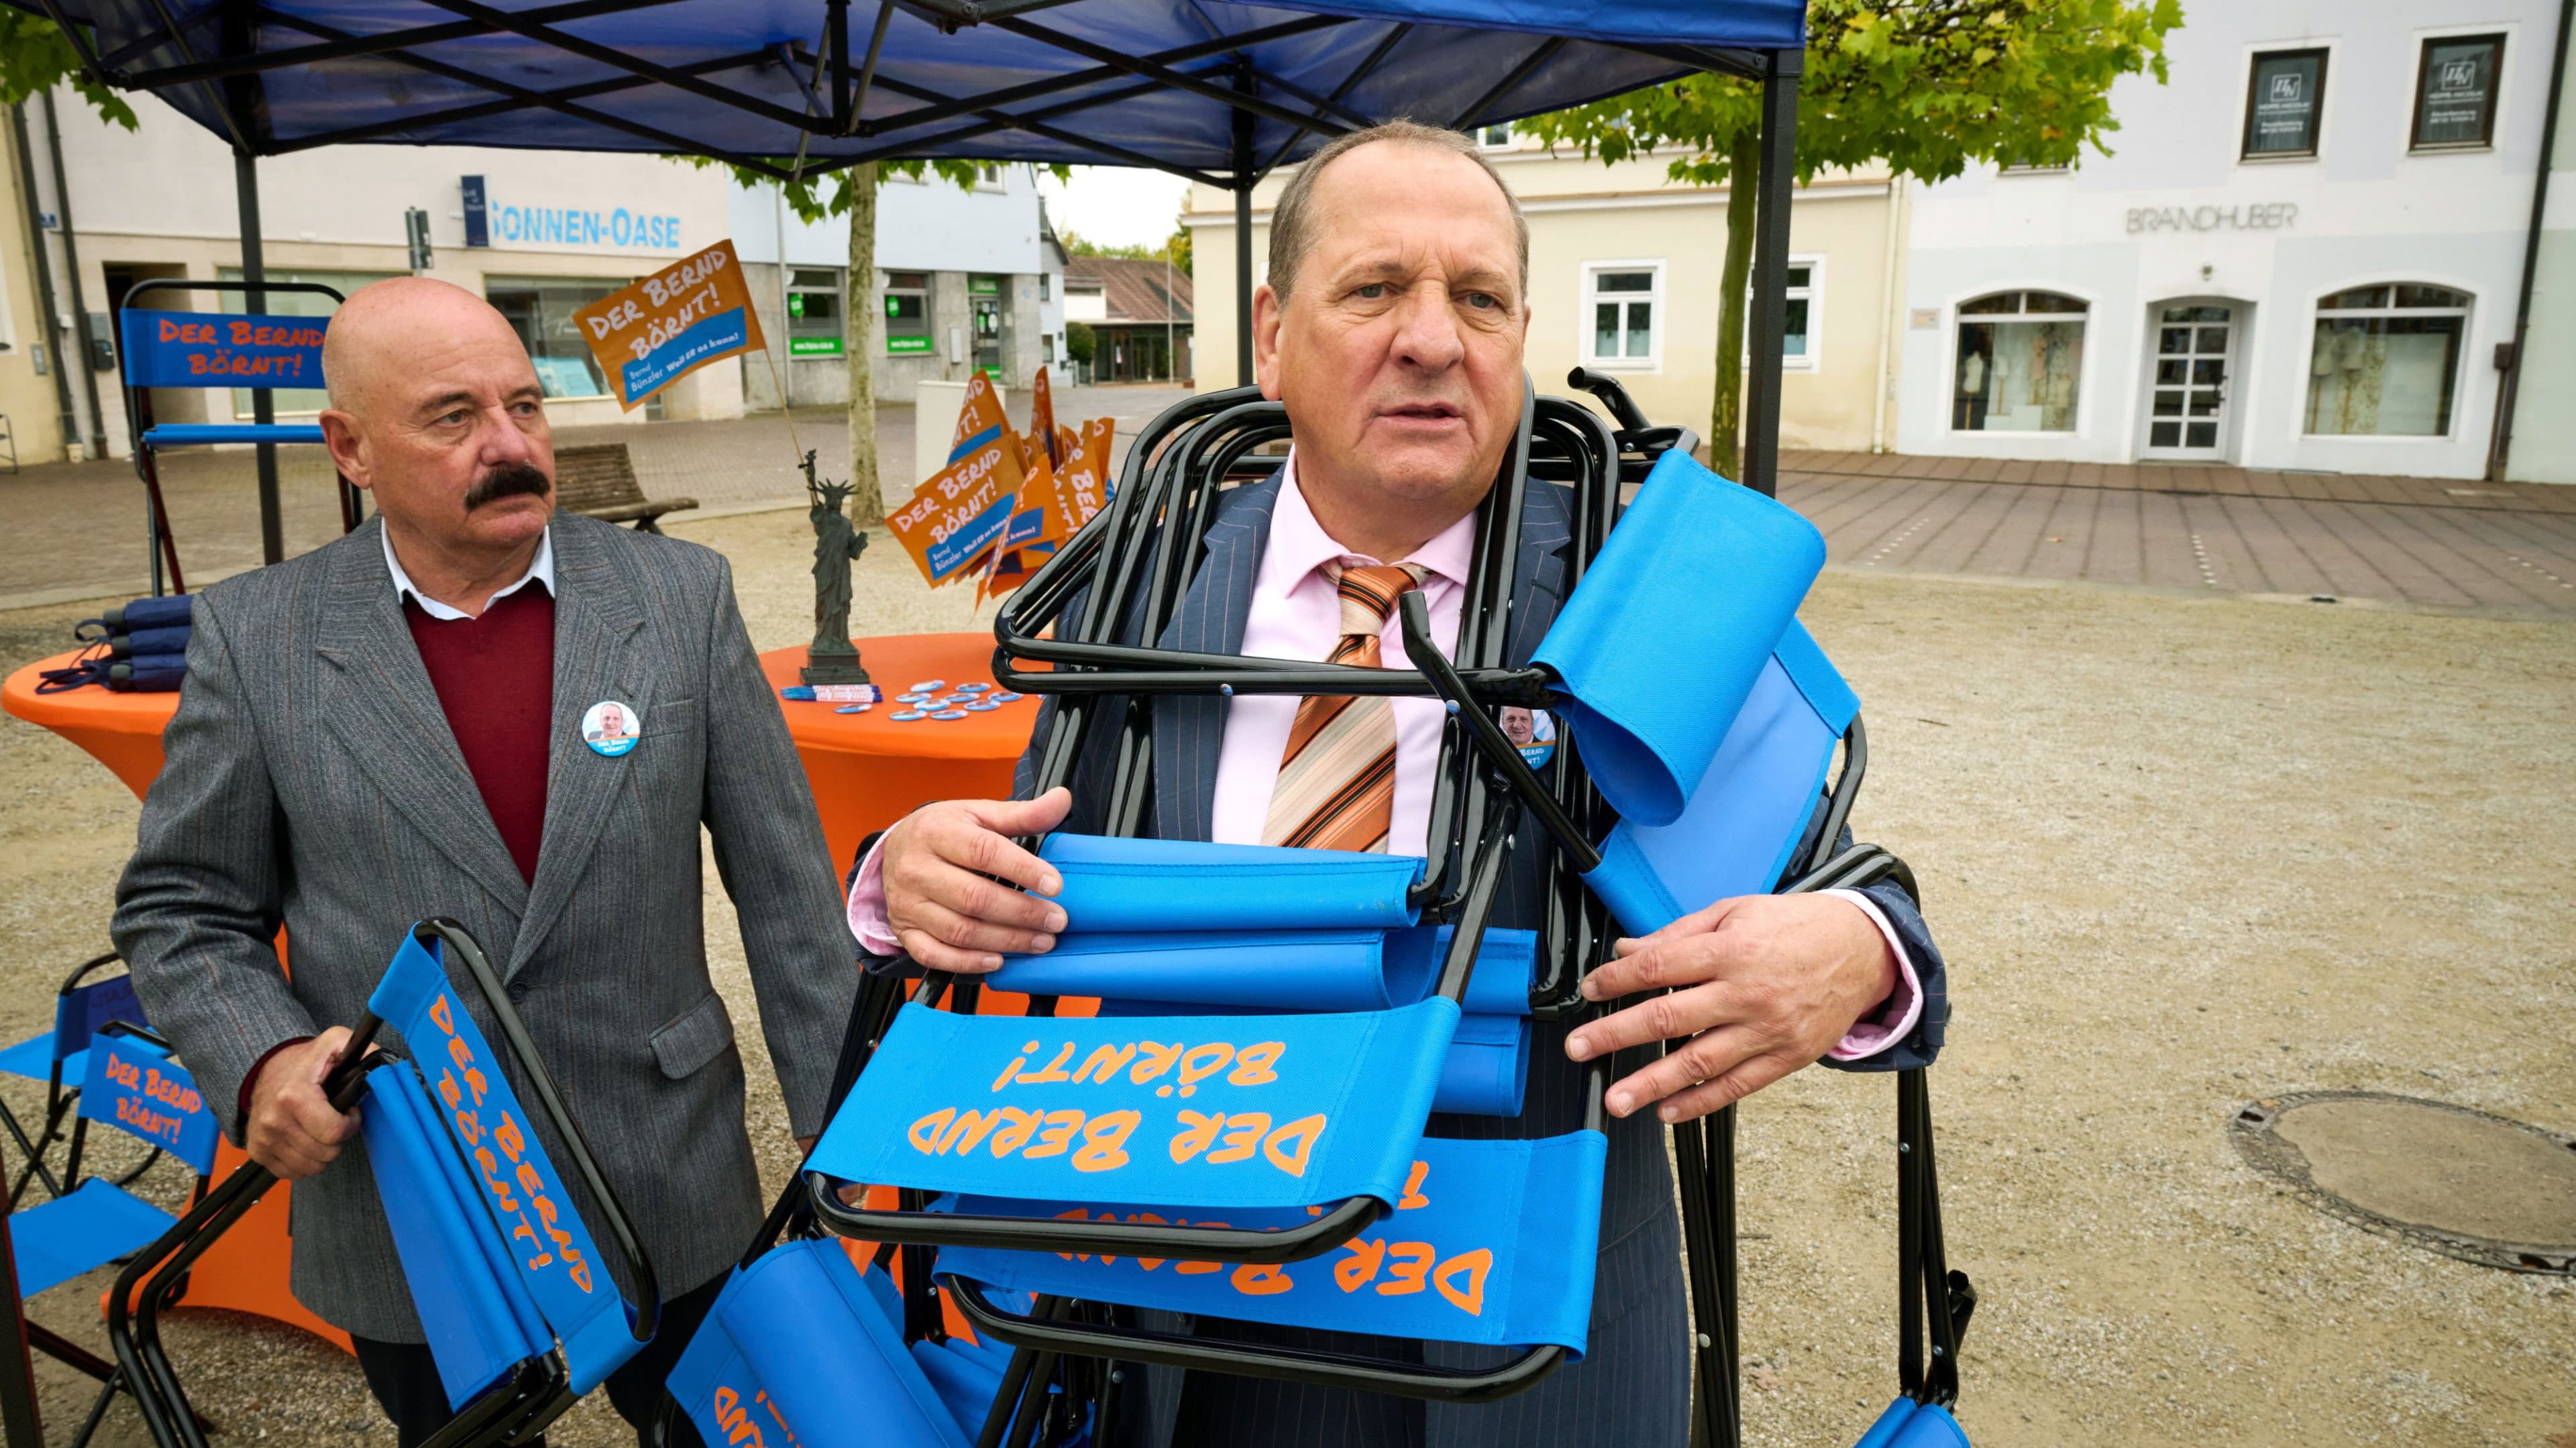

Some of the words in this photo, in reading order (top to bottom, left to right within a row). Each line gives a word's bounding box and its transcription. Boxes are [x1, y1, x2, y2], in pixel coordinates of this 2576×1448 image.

[2126, 202, 2299, 233] BRANDHUBER
[587, 300, 644, 340] DER
[642, 250, 726, 307] BERND
[629, 282, 720, 360] BÖRNT!
[159, 319, 218, 345] DER
[228, 321, 325, 348] BERND
[187, 348, 302, 377] BÖRNT!
[666, 355, 685, 372] Weil
[686, 348, 696, 359] ER
[708, 333, 739, 348] kann!
[629, 362, 651, 380] Bernd
[895, 497, 940, 533] DER
[936, 449, 1002, 500] BERND
[930, 476, 997, 545] BÖRNT!
[106, 1052, 140, 1091] DER
[145, 1068, 201, 1114] BERND
[992, 1040, 1286, 1098] BÖRNT!
[116, 1097, 182, 1144] BÖRNT!
[429, 993, 487, 1107] DER
[494, 1111, 592, 1294] BERND
[908, 1106, 1142, 1172] BERND
[1169, 1109, 1326, 1178] DER
[438, 1067, 553, 1271] BÖRNT!
[1334, 1236, 1493, 1317] DER
